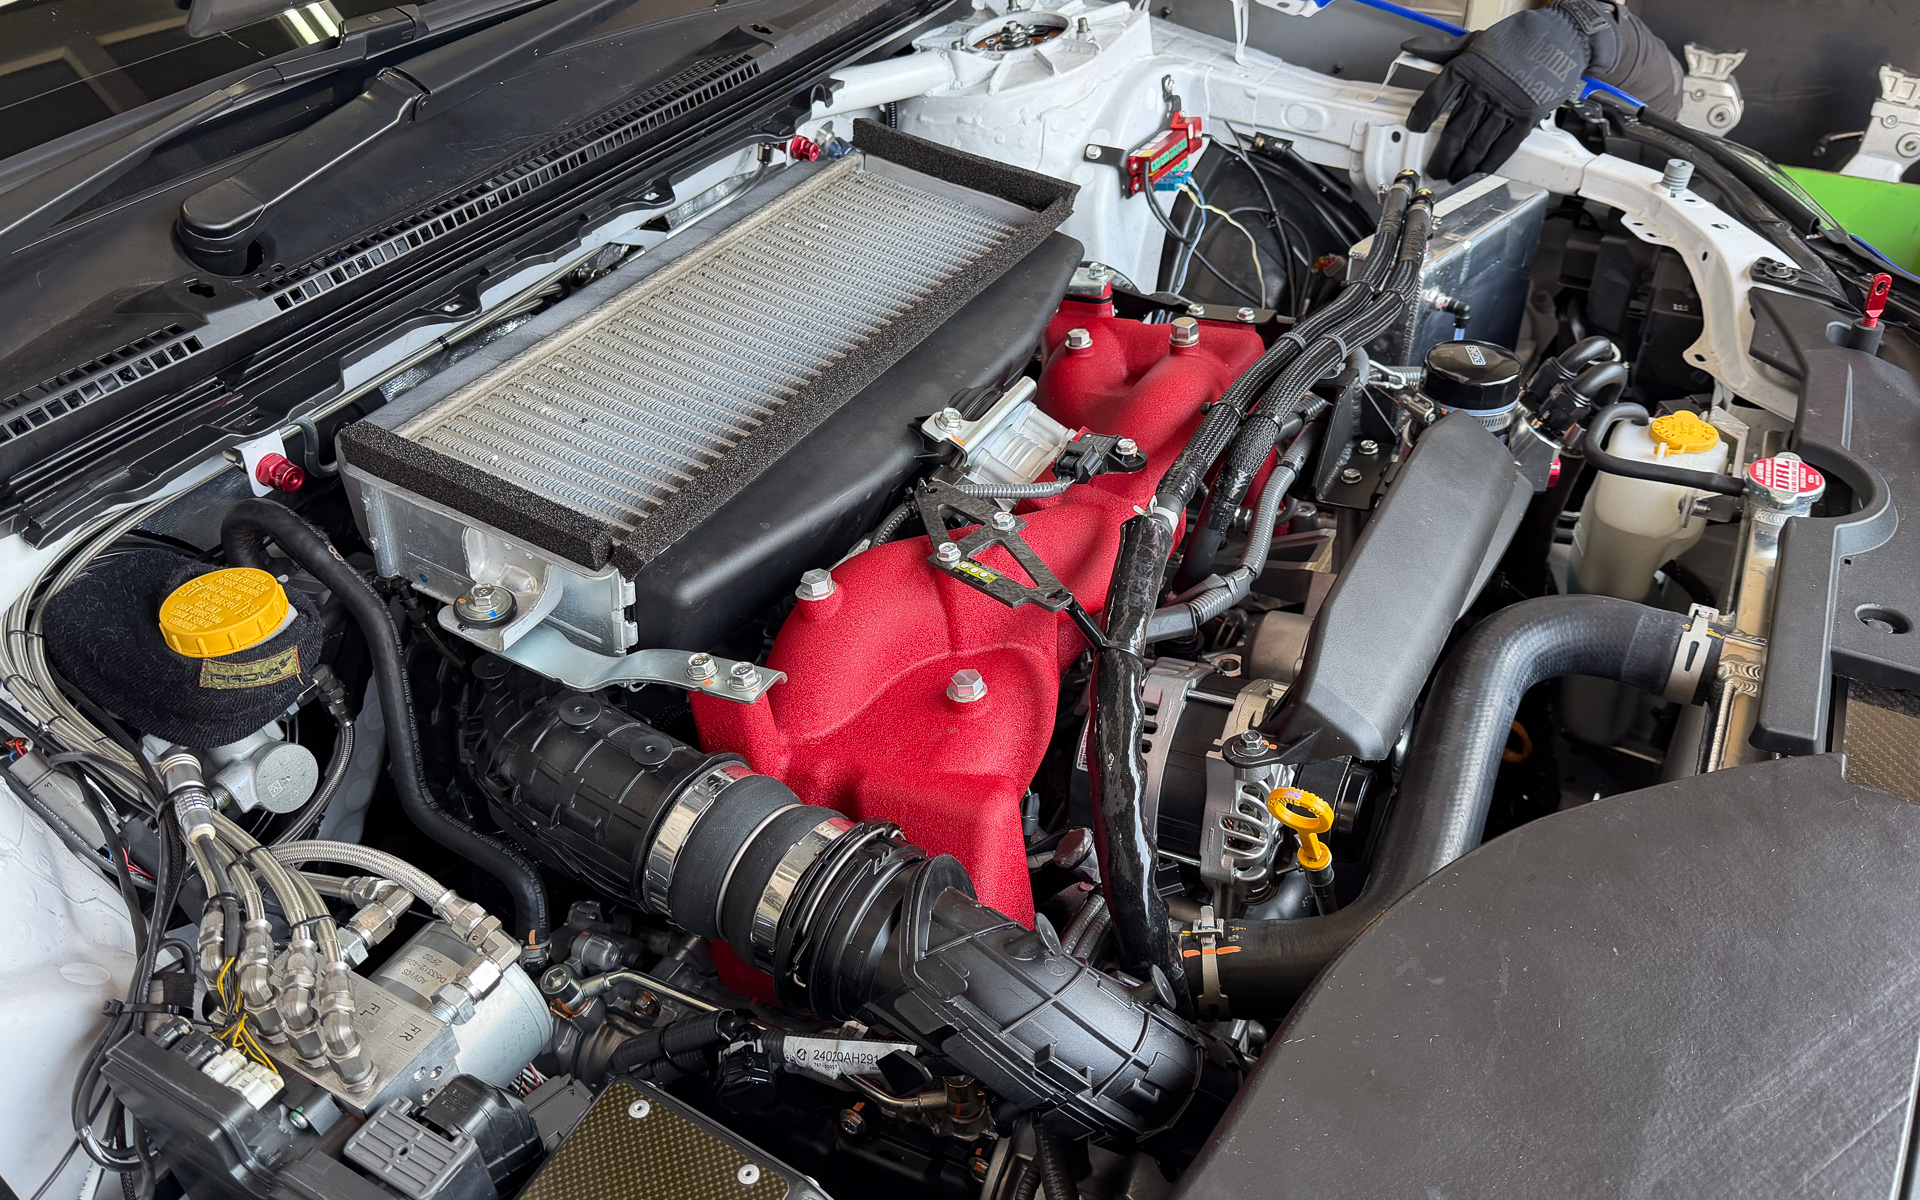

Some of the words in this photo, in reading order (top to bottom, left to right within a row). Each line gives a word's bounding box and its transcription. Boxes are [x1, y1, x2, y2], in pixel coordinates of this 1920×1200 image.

[1776, 460, 1790, 490] DRL
[422, 952, 443, 966] 2F02
[401, 968, 429, 985] ADVICS
[360, 1002, 381, 1016] FL
[399, 1023, 422, 1041] FR
[813, 1049, 879, 1064] 24020AH291
